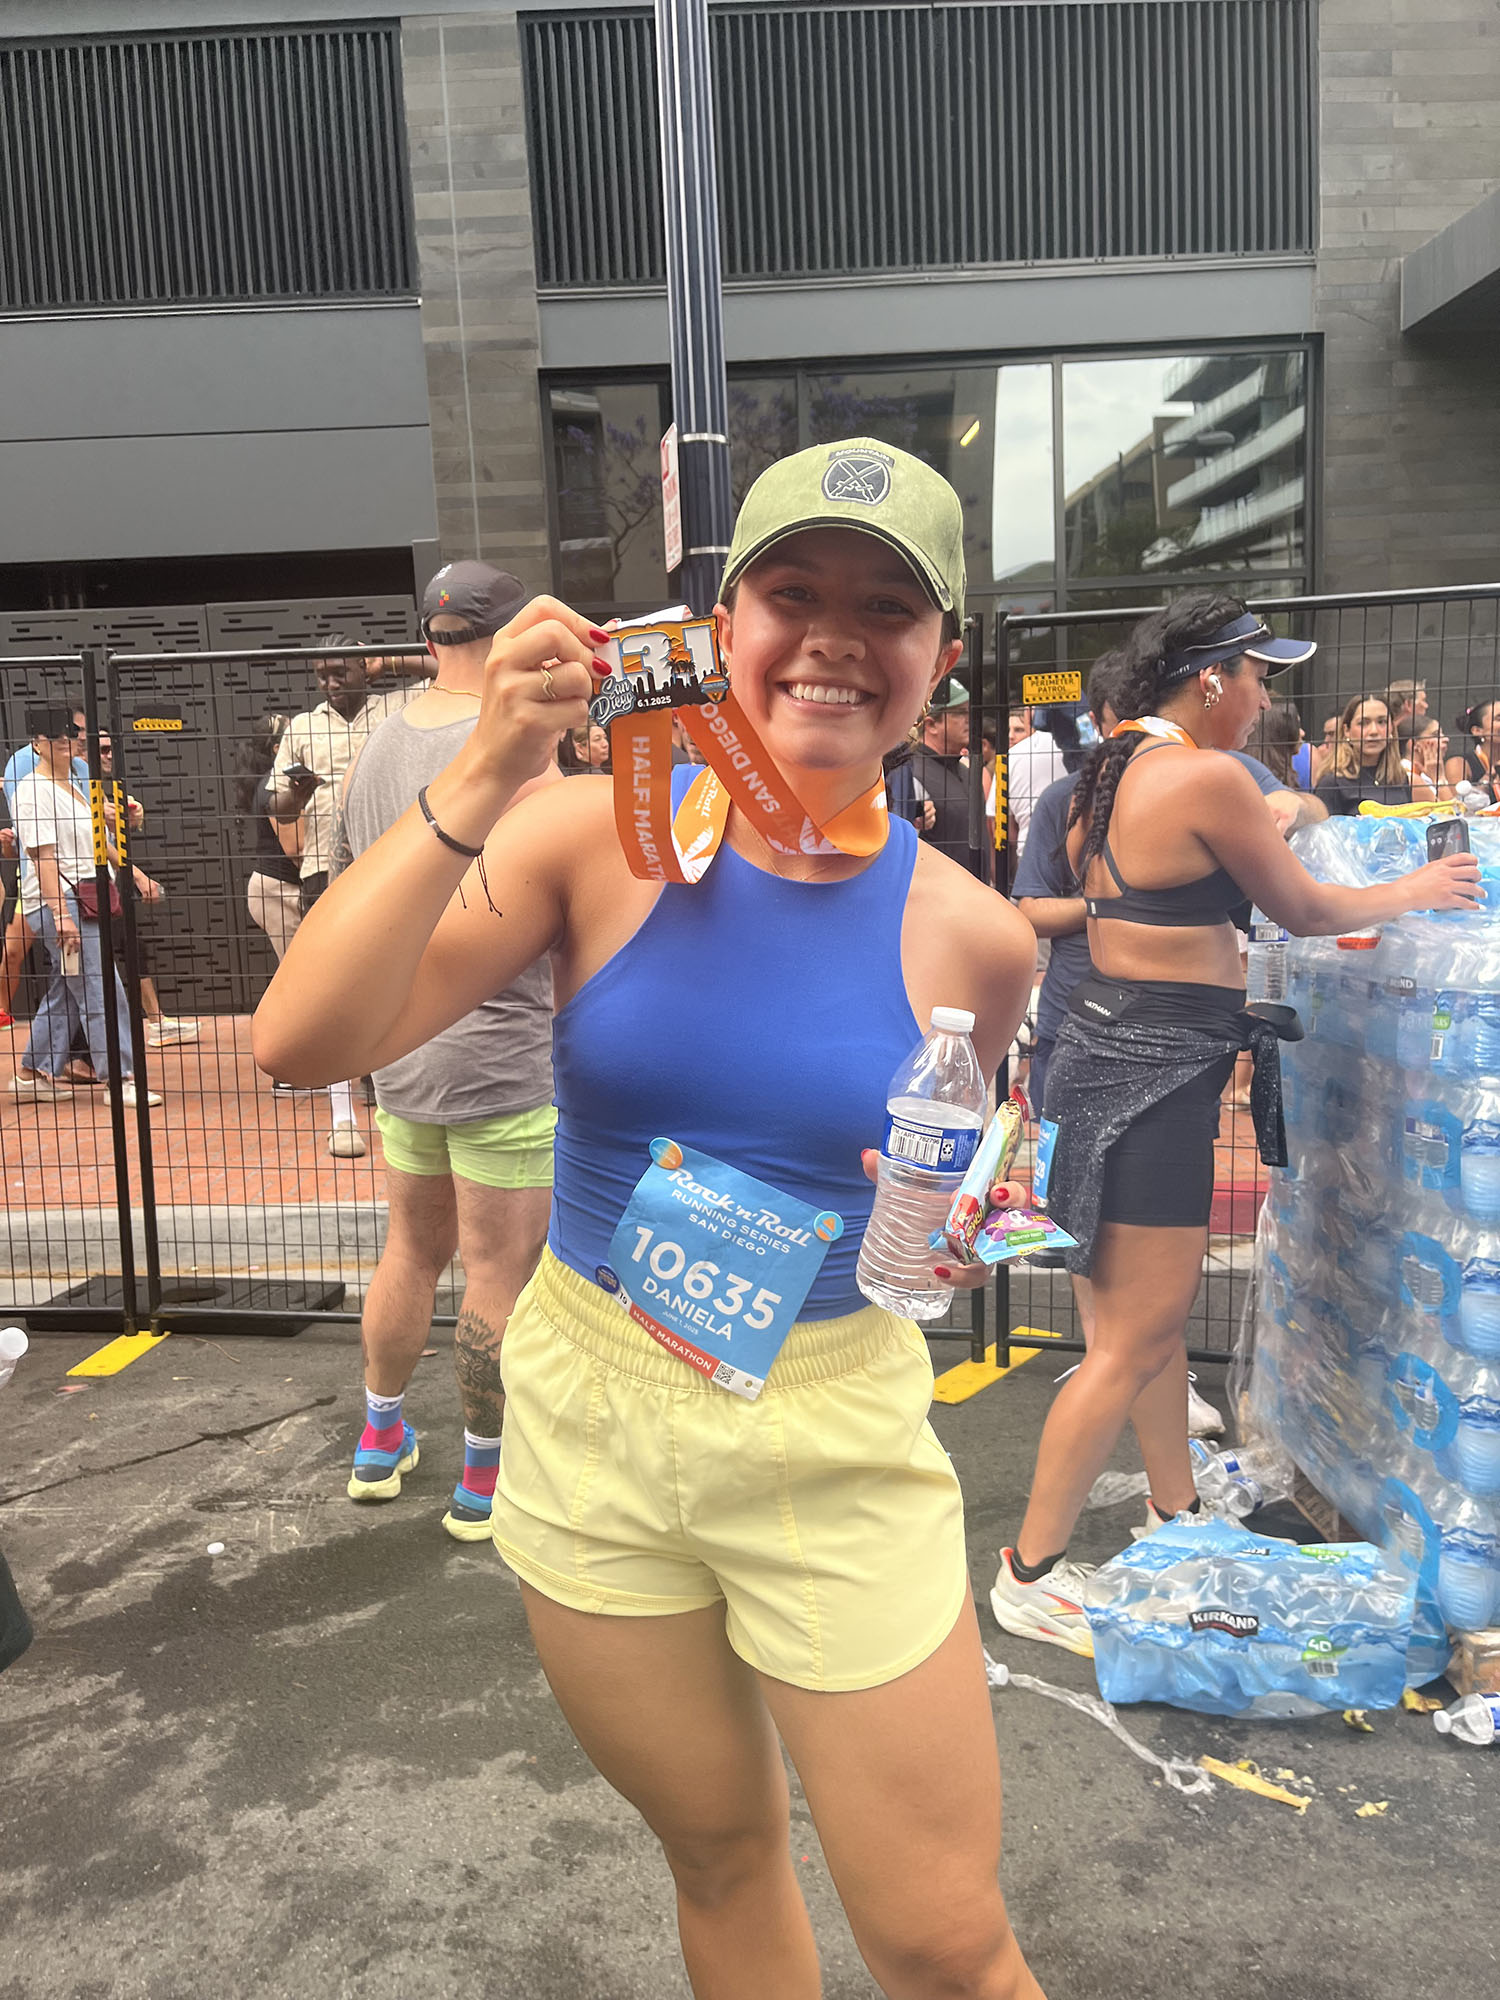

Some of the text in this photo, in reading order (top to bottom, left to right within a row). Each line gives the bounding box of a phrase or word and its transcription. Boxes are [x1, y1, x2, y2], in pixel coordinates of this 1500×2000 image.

[836, 448, 889, 461] MOUNTAIN
[602, 677, 630, 698] San
[1031, 678, 1074, 687] PERIMETER
[1038, 685, 1066, 694] PATROL
[588, 690, 635, 725] Diego
[637, 696, 672, 708] 6.1.2025
[700, 702, 752, 770] DIEGO
[631, 736, 650, 802] HALF
[743, 771, 780, 813] SAN
[918, 1135, 940, 1145] 782796
[667, 1168, 734, 1212] Rock
[755, 1208, 812, 1248] Roll
[671, 1189, 791, 1254] RUNNING SERIES
[688, 1213, 766, 1256] SAN DIEGO
[631, 1225, 782, 1330] 10635
[641, 1276, 733, 1341] DANIELA
[662, 1310, 678, 1324] JUNE
[684, 1322, 700, 1336] 2025
[632, 1310, 712, 1371] HALF MARATHON
[1191, 1611, 1258, 1631] KIRKAND
